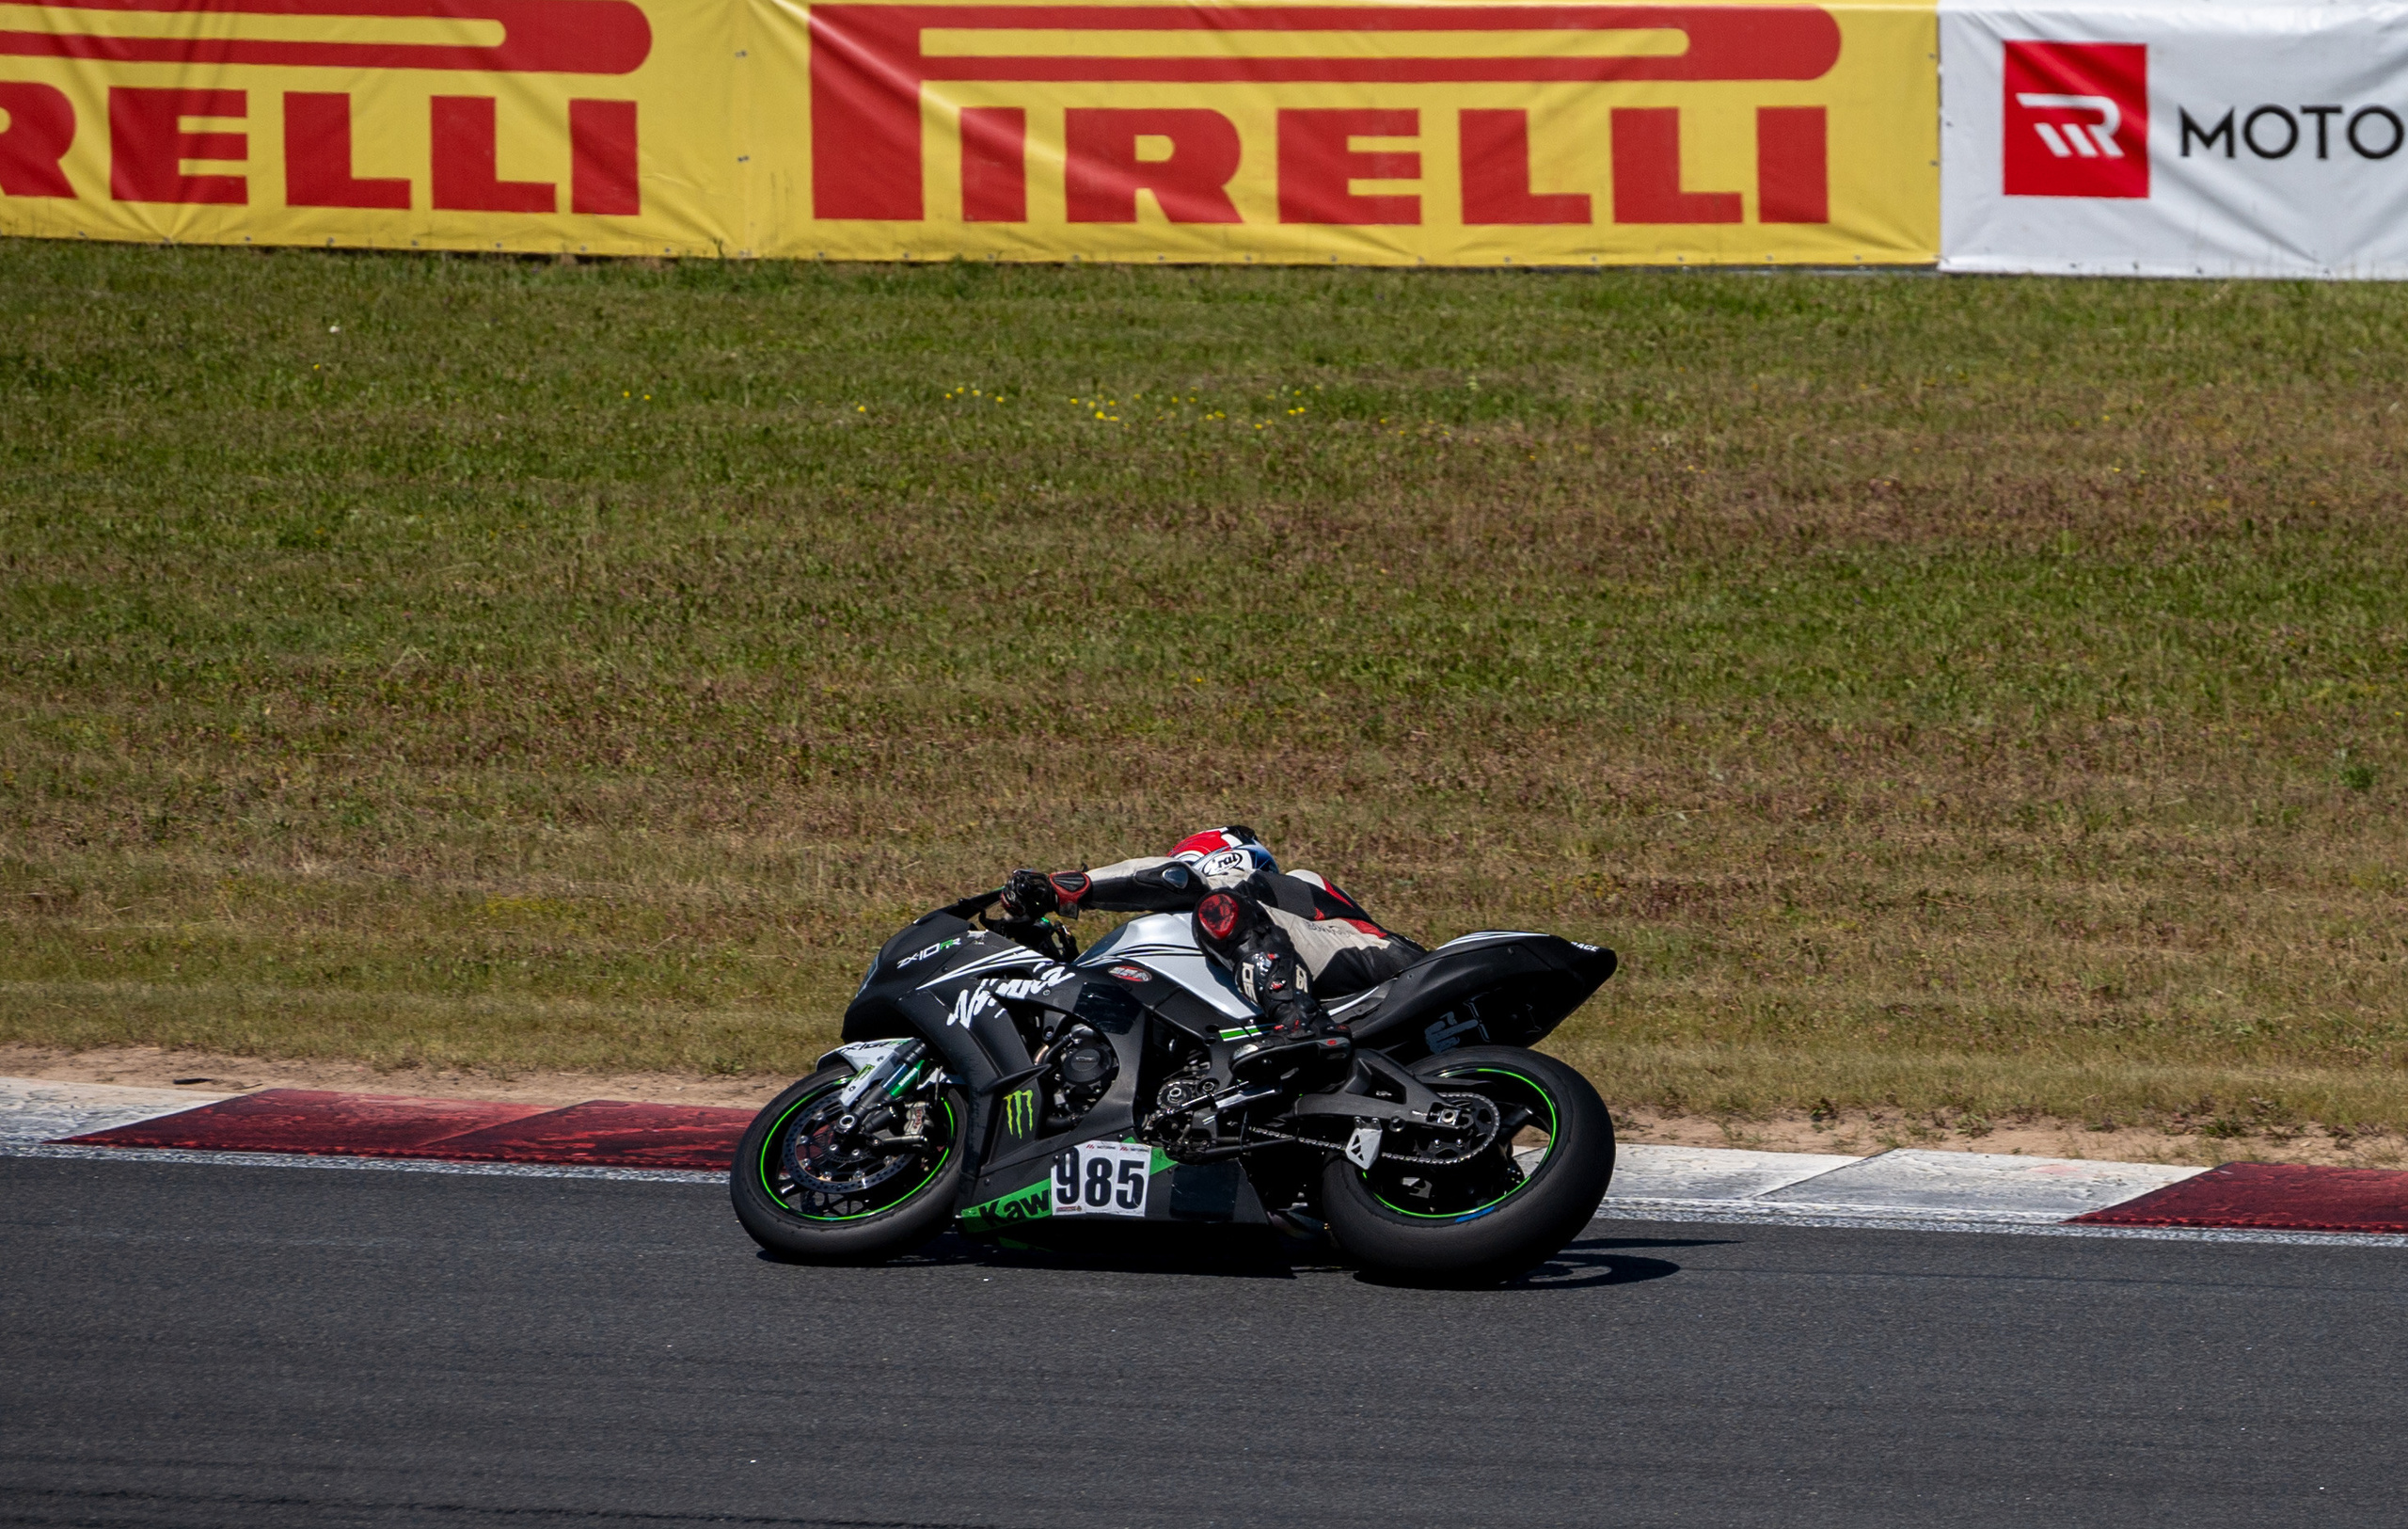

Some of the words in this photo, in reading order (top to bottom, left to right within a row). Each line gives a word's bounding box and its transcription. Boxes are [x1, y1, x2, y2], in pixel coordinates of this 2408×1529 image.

[809, 4, 1841, 224] PIRELLI
[2178, 104, 2404, 160] MOTO
[946, 962, 1075, 1028] Ninja
[978, 1189, 1051, 1226] Kaw
[1055, 1147, 1145, 1210] 985
